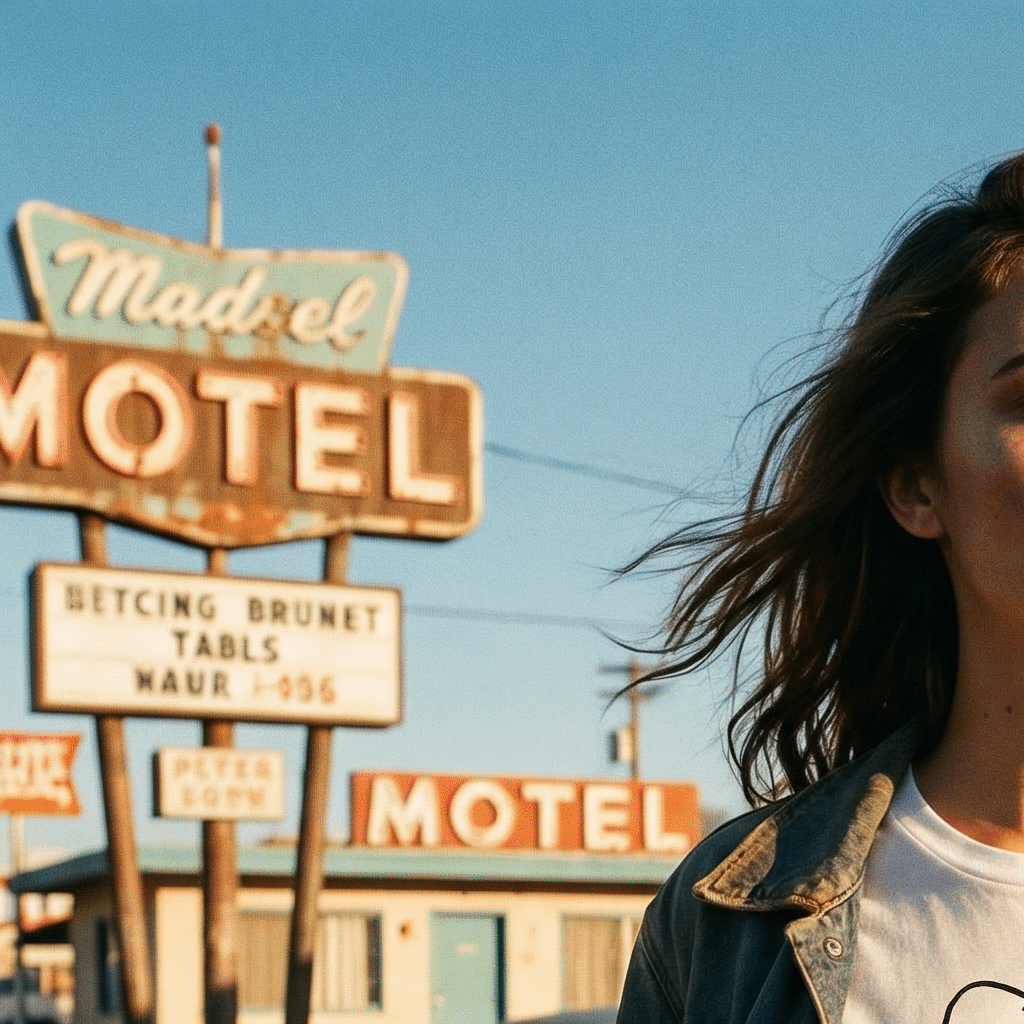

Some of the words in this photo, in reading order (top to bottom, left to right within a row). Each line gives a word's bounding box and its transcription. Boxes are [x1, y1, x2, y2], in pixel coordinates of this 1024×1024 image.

[0, 350, 460, 504] MOTEL
[247, 593, 382, 633] BRUNET
[171, 629, 281, 664] TABLS
[366, 774, 691, 852] MOTEL
